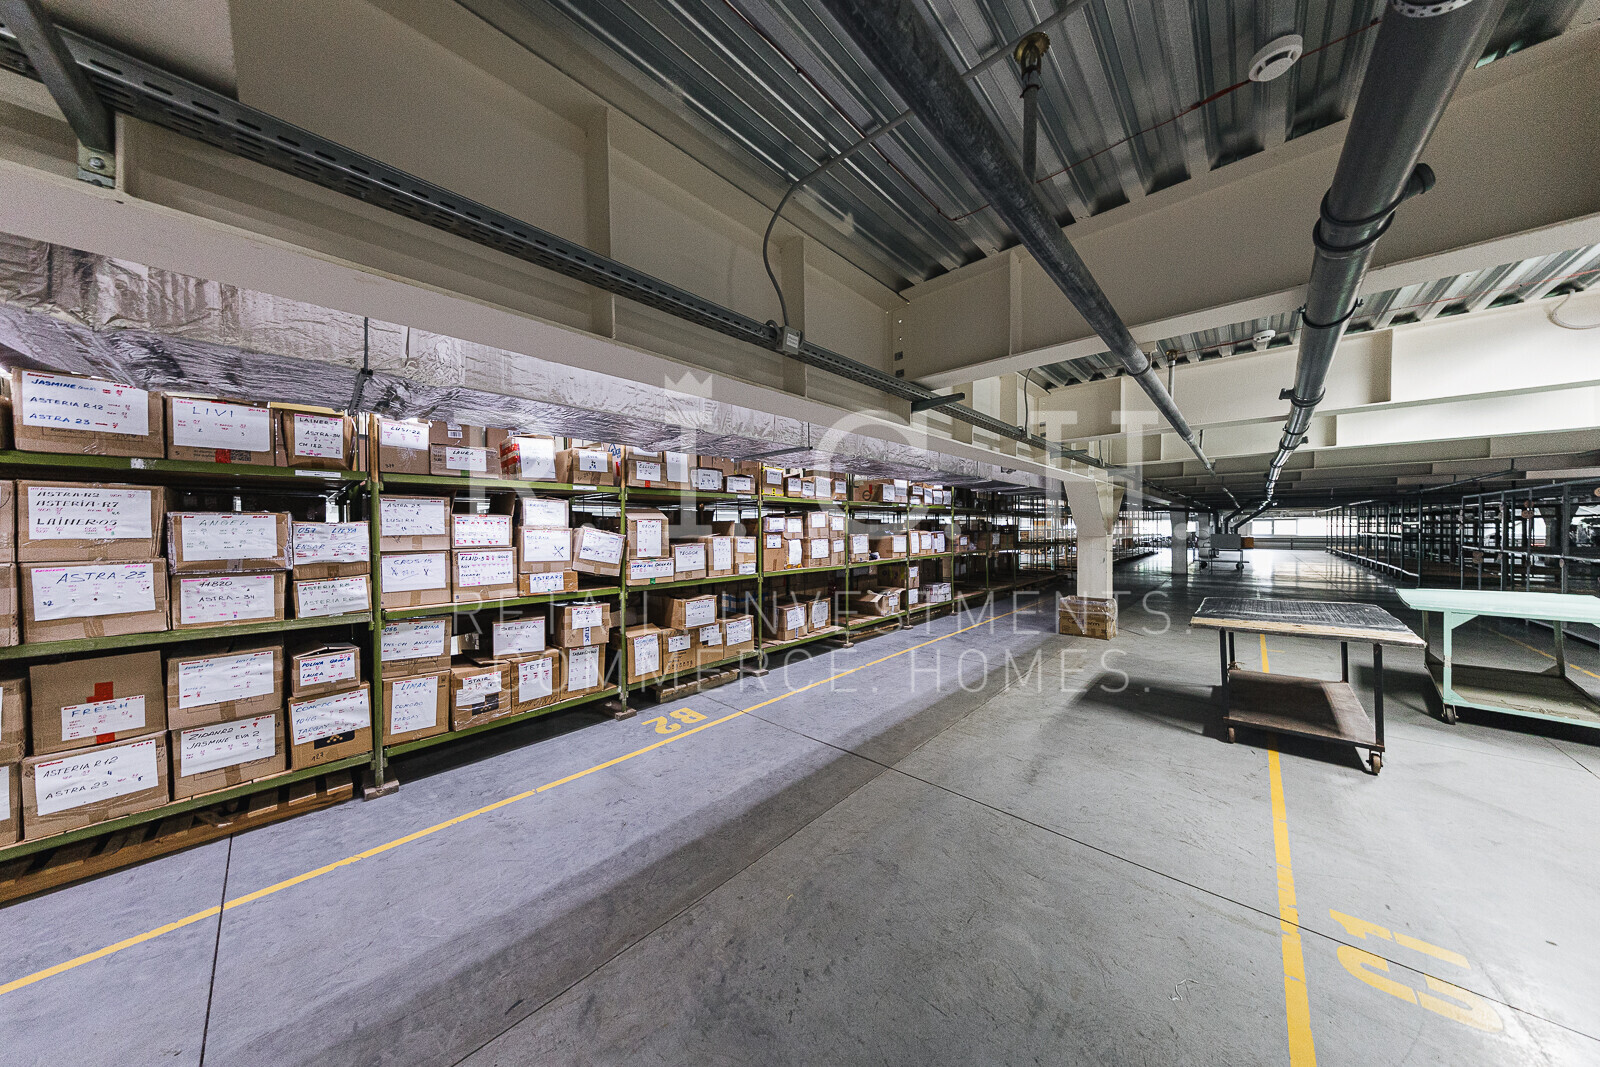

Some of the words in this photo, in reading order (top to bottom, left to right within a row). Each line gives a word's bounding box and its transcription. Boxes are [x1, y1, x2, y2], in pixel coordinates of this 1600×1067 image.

[31, 378, 77, 390] JASMINE
[29, 396, 80, 408] ASTERIA
[29, 413, 71, 423] ASTRA
[192, 406, 234, 418] LIVI
[71, 702, 128, 717] FRESH
[641, 707, 709, 735] B2
[187, 737, 231, 750] JASMINE
[43, 763, 90, 778] ASTERIA
[46, 785, 86, 800] ASTRA
